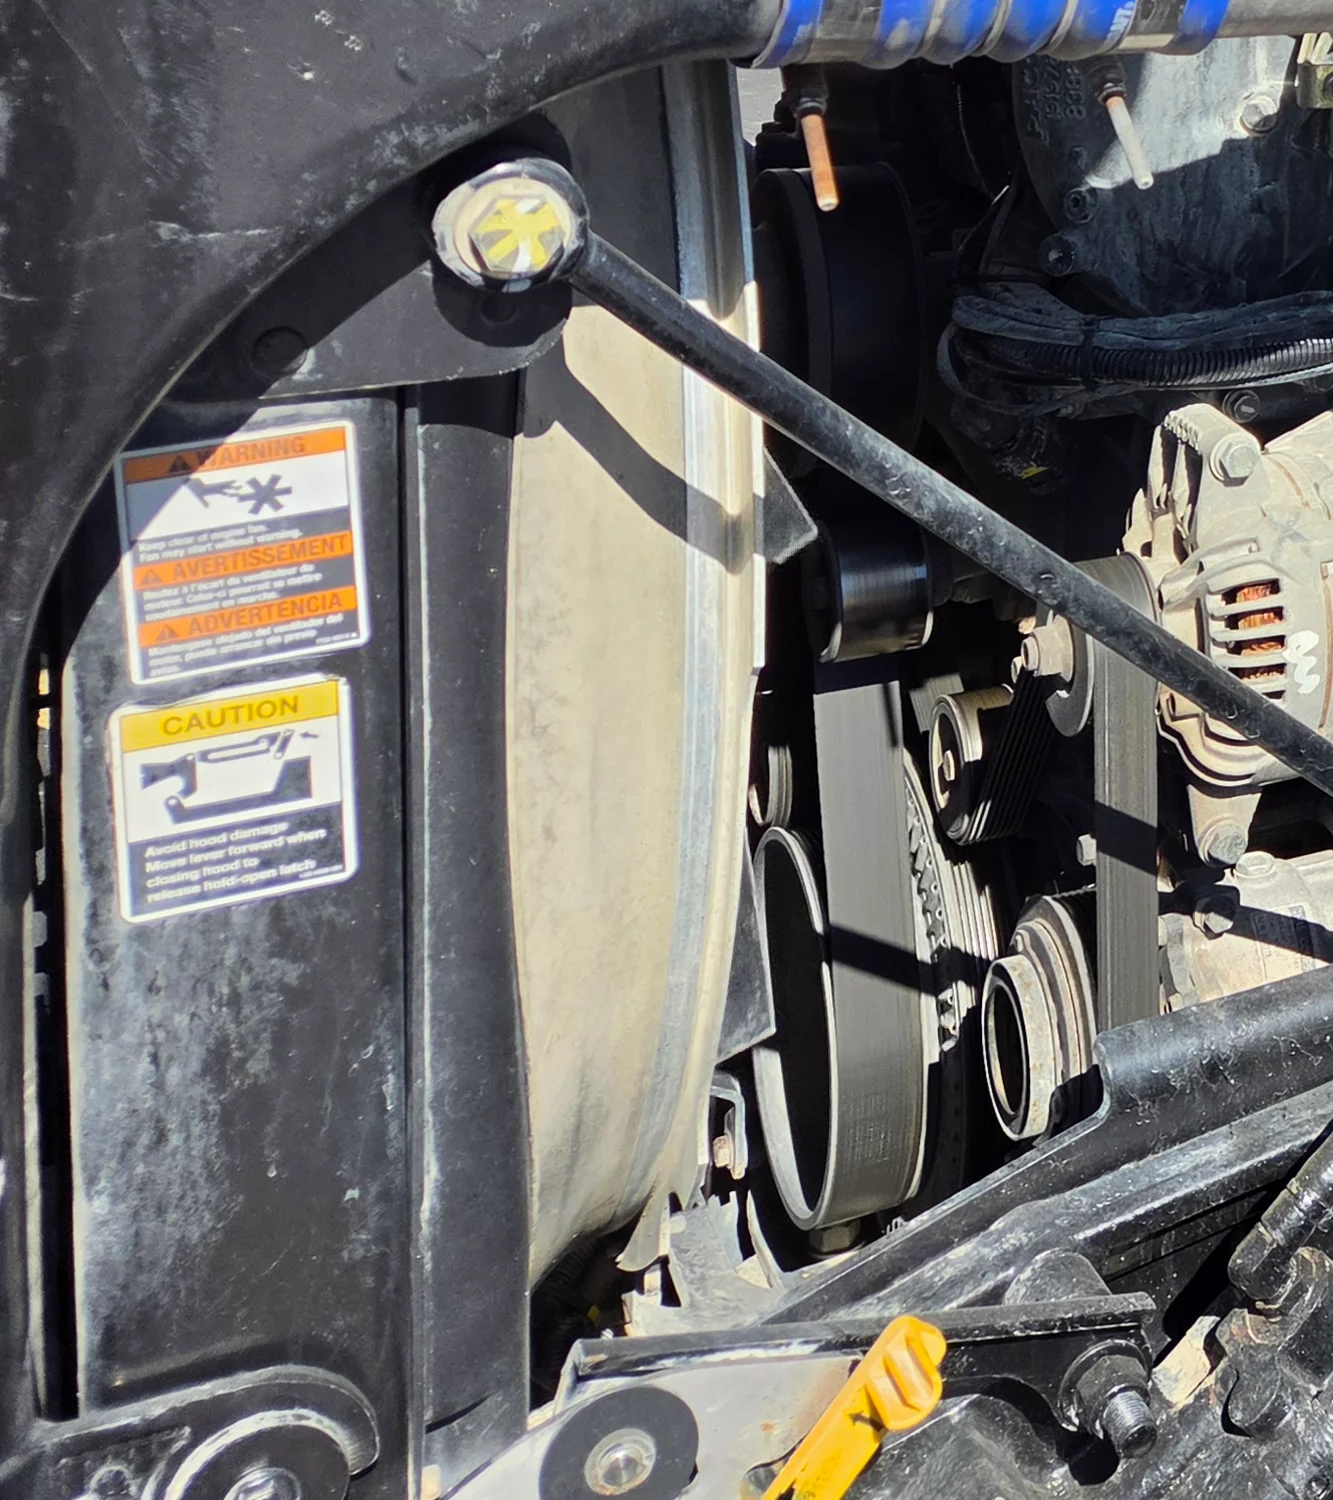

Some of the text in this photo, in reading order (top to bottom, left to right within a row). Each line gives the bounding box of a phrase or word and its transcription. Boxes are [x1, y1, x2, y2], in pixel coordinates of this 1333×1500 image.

[196, 435, 305, 467] WARNING
[172, 534, 346, 580] AVERTISSEMENT
[188, 592, 342, 635] ADVERTENCIA
[161, 695, 299, 736] CAUTION
[144, 840, 186, 857] Avoid
[189, 833, 228, 849] hood
[146, 857, 186, 873] Move
[189, 849, 225, 864] lever
[202, 860, 241, 876] hood
